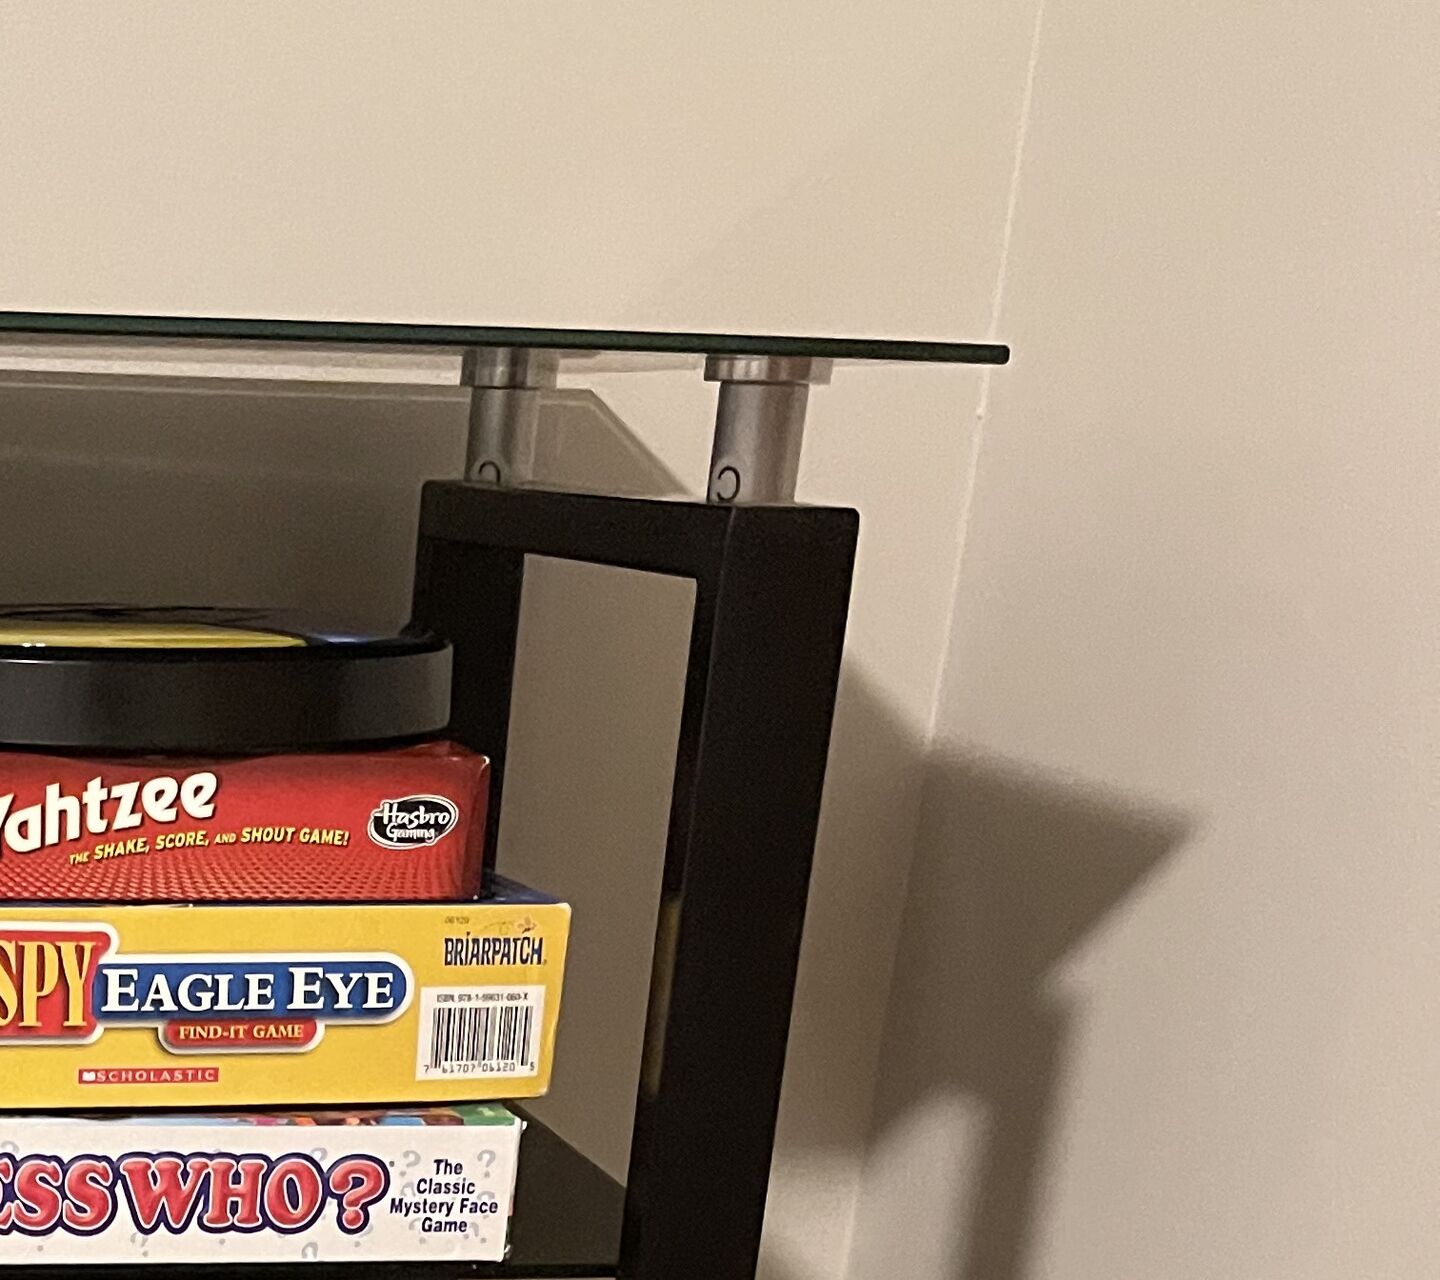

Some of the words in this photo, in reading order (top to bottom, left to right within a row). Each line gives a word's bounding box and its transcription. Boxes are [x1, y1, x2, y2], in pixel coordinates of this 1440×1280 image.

[374, 800, 454, 828] Hasbro
[386, 823, 438, 843] Gaming
[69, 851, 89, 866] THE
[94, 837, 151, 862] SHAKE,
[154, 830, 210, 851] SCORE,
[213, 832, 237, 845] AND
[241, 826, 296, 845] SHOUT
[299, 827, 352, 847] GAME!
[101, 967, 276, 1012] EAGLE
[286, 965, 395, 1011] EYE
[178, 1024, 250, 1041] FIND-IT
[252, 1023, 305, 1040] GAME
[95, 1068, 216, 1083] SCHOLASTIC
[433, 1158, 464, 1175] The
[118, 1152, 391, 1236] WHO?
[416, 1177, 476, 1195] Classic
[389, 1197, 455, 1217] Mystery
[459, 1197, 499, 1215] Face
[421, 1216, 468, 1233] Game
